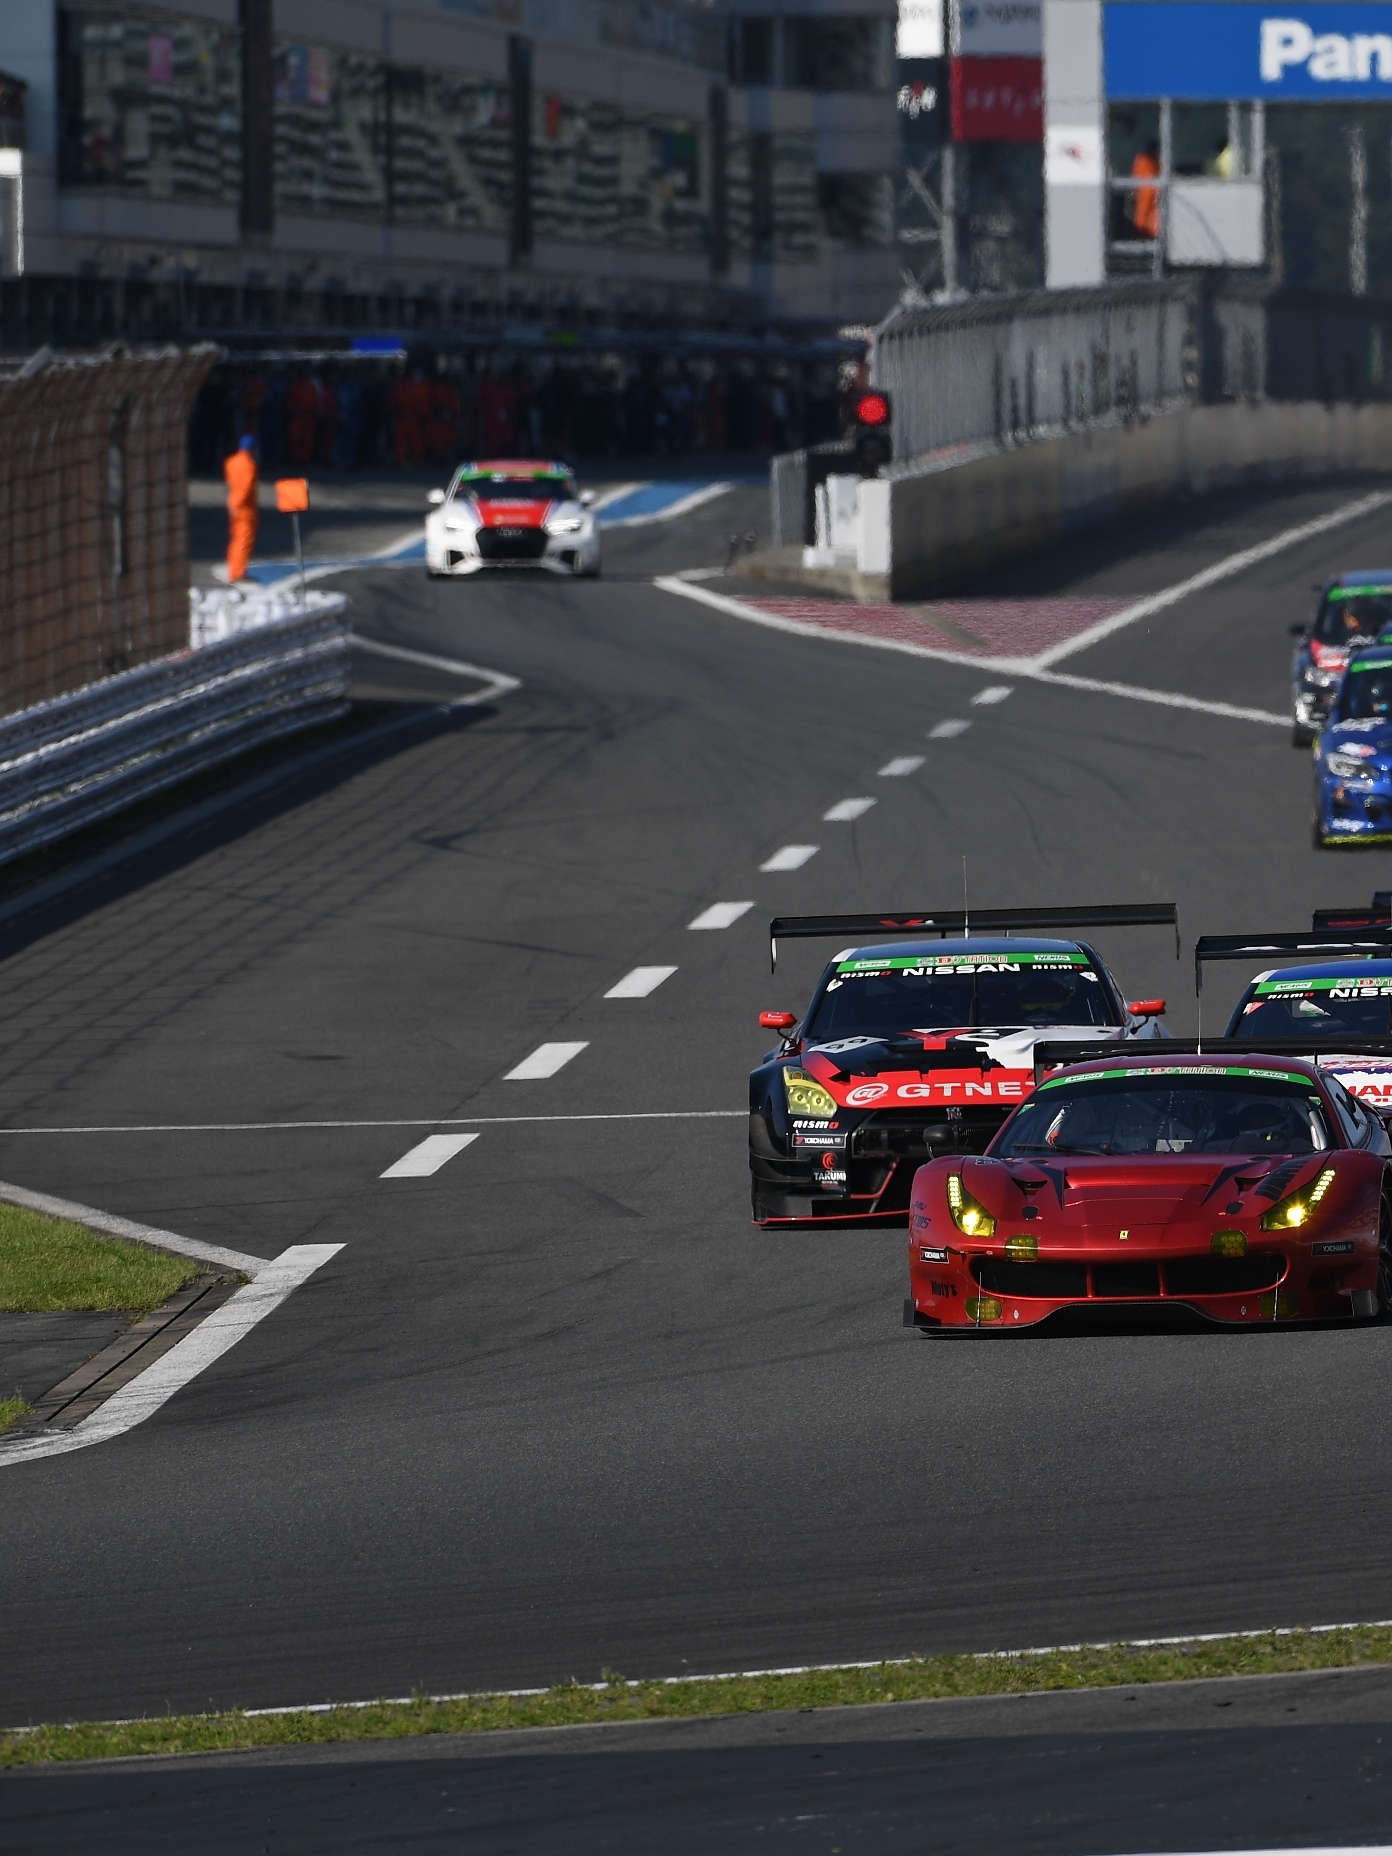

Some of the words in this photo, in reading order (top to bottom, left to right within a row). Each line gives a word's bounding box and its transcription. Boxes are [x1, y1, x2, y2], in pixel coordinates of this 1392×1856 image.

[840, 970, 892, 979] nismo
[902, 963, 1021, 977] NISSAN
[1266, 992, 1314, 1000] nismo
[792, 1119, 839, 1129] nismo
[804, 1137, 834, 1145] YOKOHAMA
[813, 1170, 847, 1181] TAKUMI
[1322, 1244, 1348, 1252] YOKOHAMA
